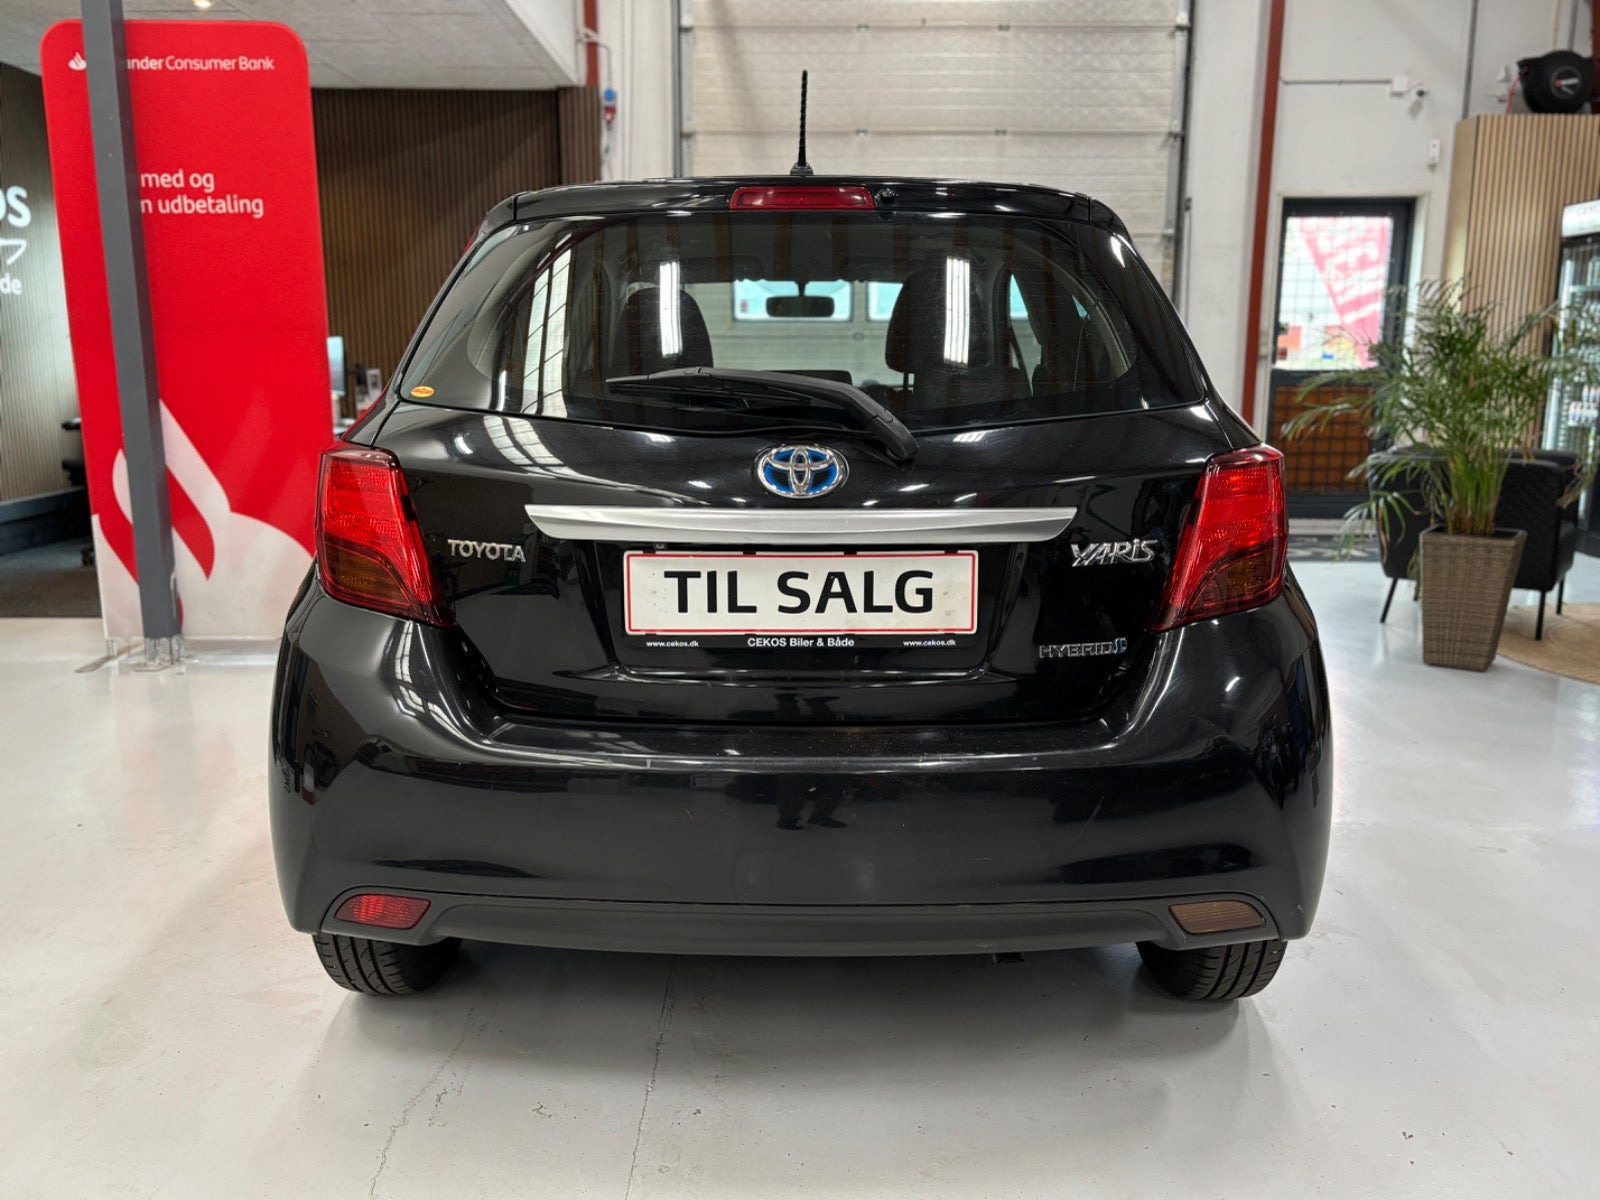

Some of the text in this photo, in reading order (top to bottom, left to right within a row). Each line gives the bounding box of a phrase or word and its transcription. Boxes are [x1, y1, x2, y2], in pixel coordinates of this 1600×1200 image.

[165, 56, 236, 70] Consumer
[238, 56, 275, 70] Bank
[140, 168, 215, 193] med og
[0, 186, 31, 228] S
[158, 194, 264, 218] udbetaling
[0, 272, 22, 295] de
[447, 539, 526, 562] TOYOTA
[664, 570, 933, 614] TIL SALG
[747, 636, 855, 647] CEKOS Biler & Både
[903, 639, 956, 647] www.cekos.dk
[1039, 641, 1114, 658] HYBRID
